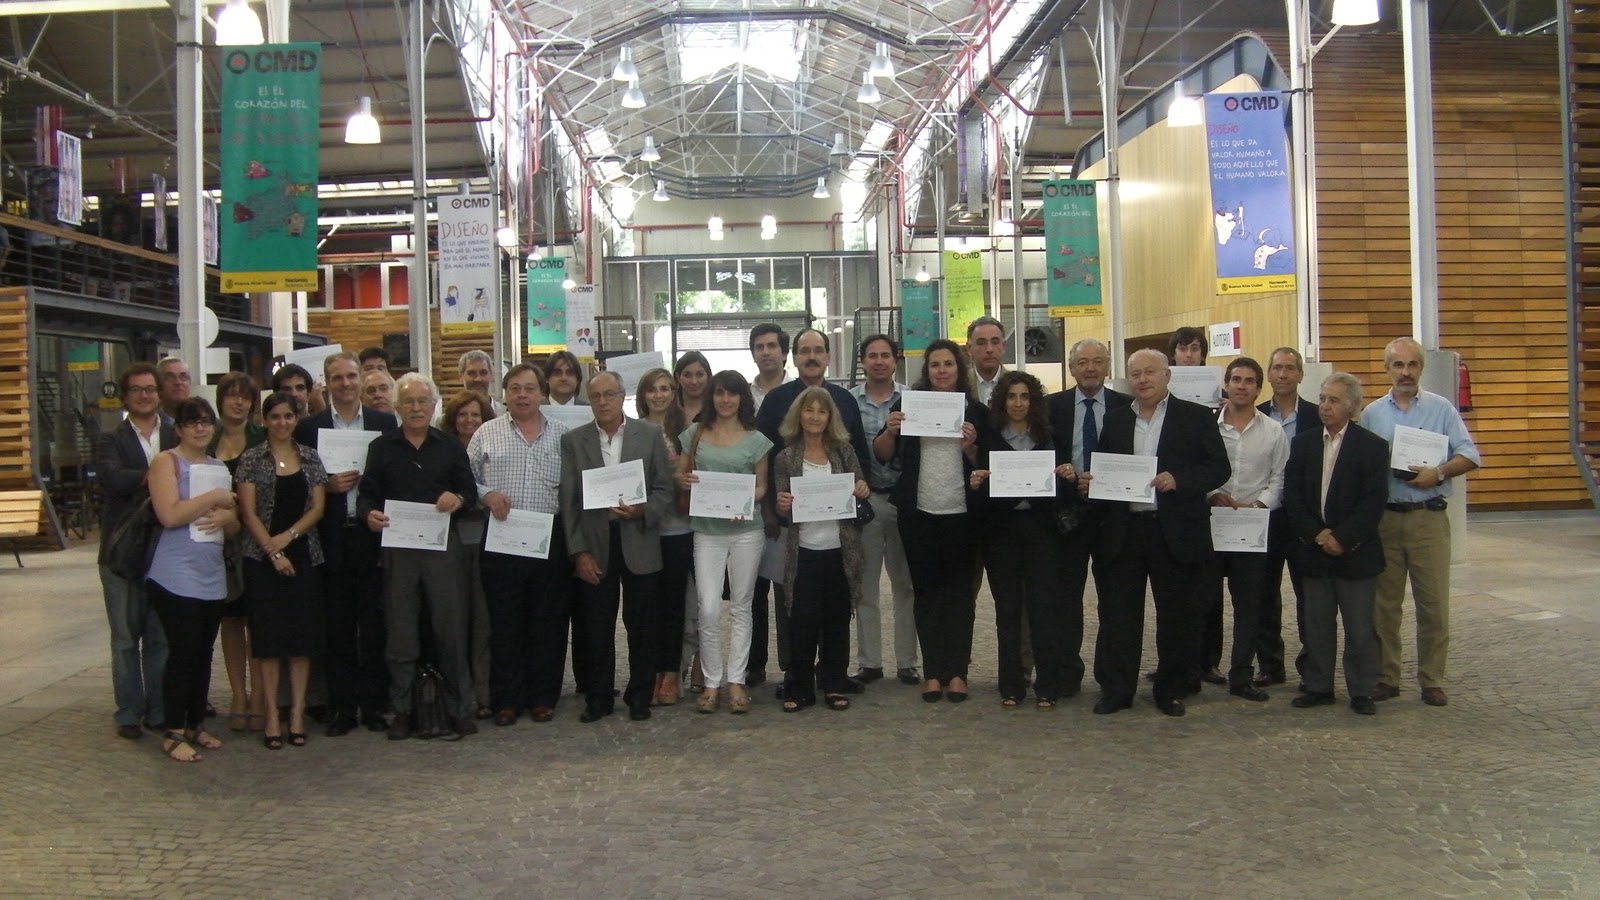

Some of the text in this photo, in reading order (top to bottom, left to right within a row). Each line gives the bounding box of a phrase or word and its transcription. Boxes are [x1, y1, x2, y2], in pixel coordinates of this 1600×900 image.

[254, 51, 316, 73] CMD
[259, 85, 284, 96] ES EL
[235, 98, 308, 109] CORAZÓN DEL
[1241, 96, 1278, 110] CMD
[1061, 184, 1095, 196] CMD
[463, 198, 490, 208] CMD
[442, 220, 488, 240] DISEÑO
[540, 260, 564, 269] CMD
